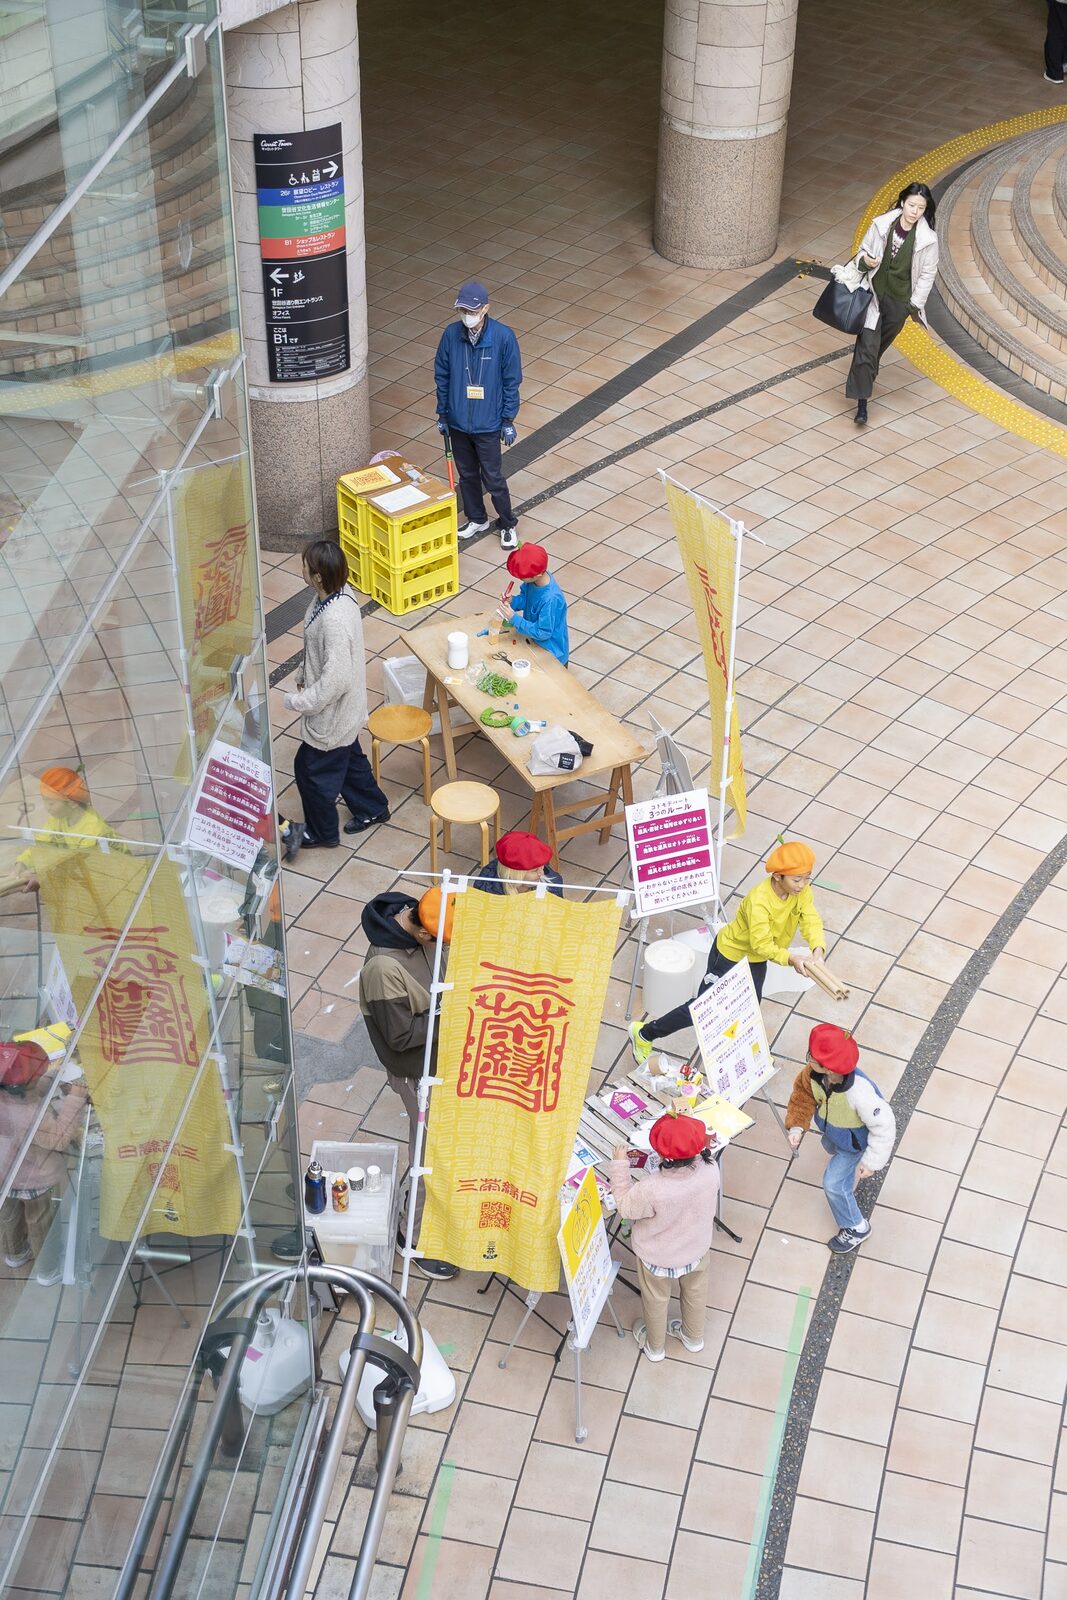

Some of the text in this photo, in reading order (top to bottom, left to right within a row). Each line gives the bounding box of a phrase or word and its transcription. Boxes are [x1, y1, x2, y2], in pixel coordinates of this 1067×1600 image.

[320, 180, 339, 190] レストラン
[271, 287, 283, 297] 1F
[648, 803, 692, 819] 3つのルール
[455, 1178, 538, 1208] 三茶縁日
